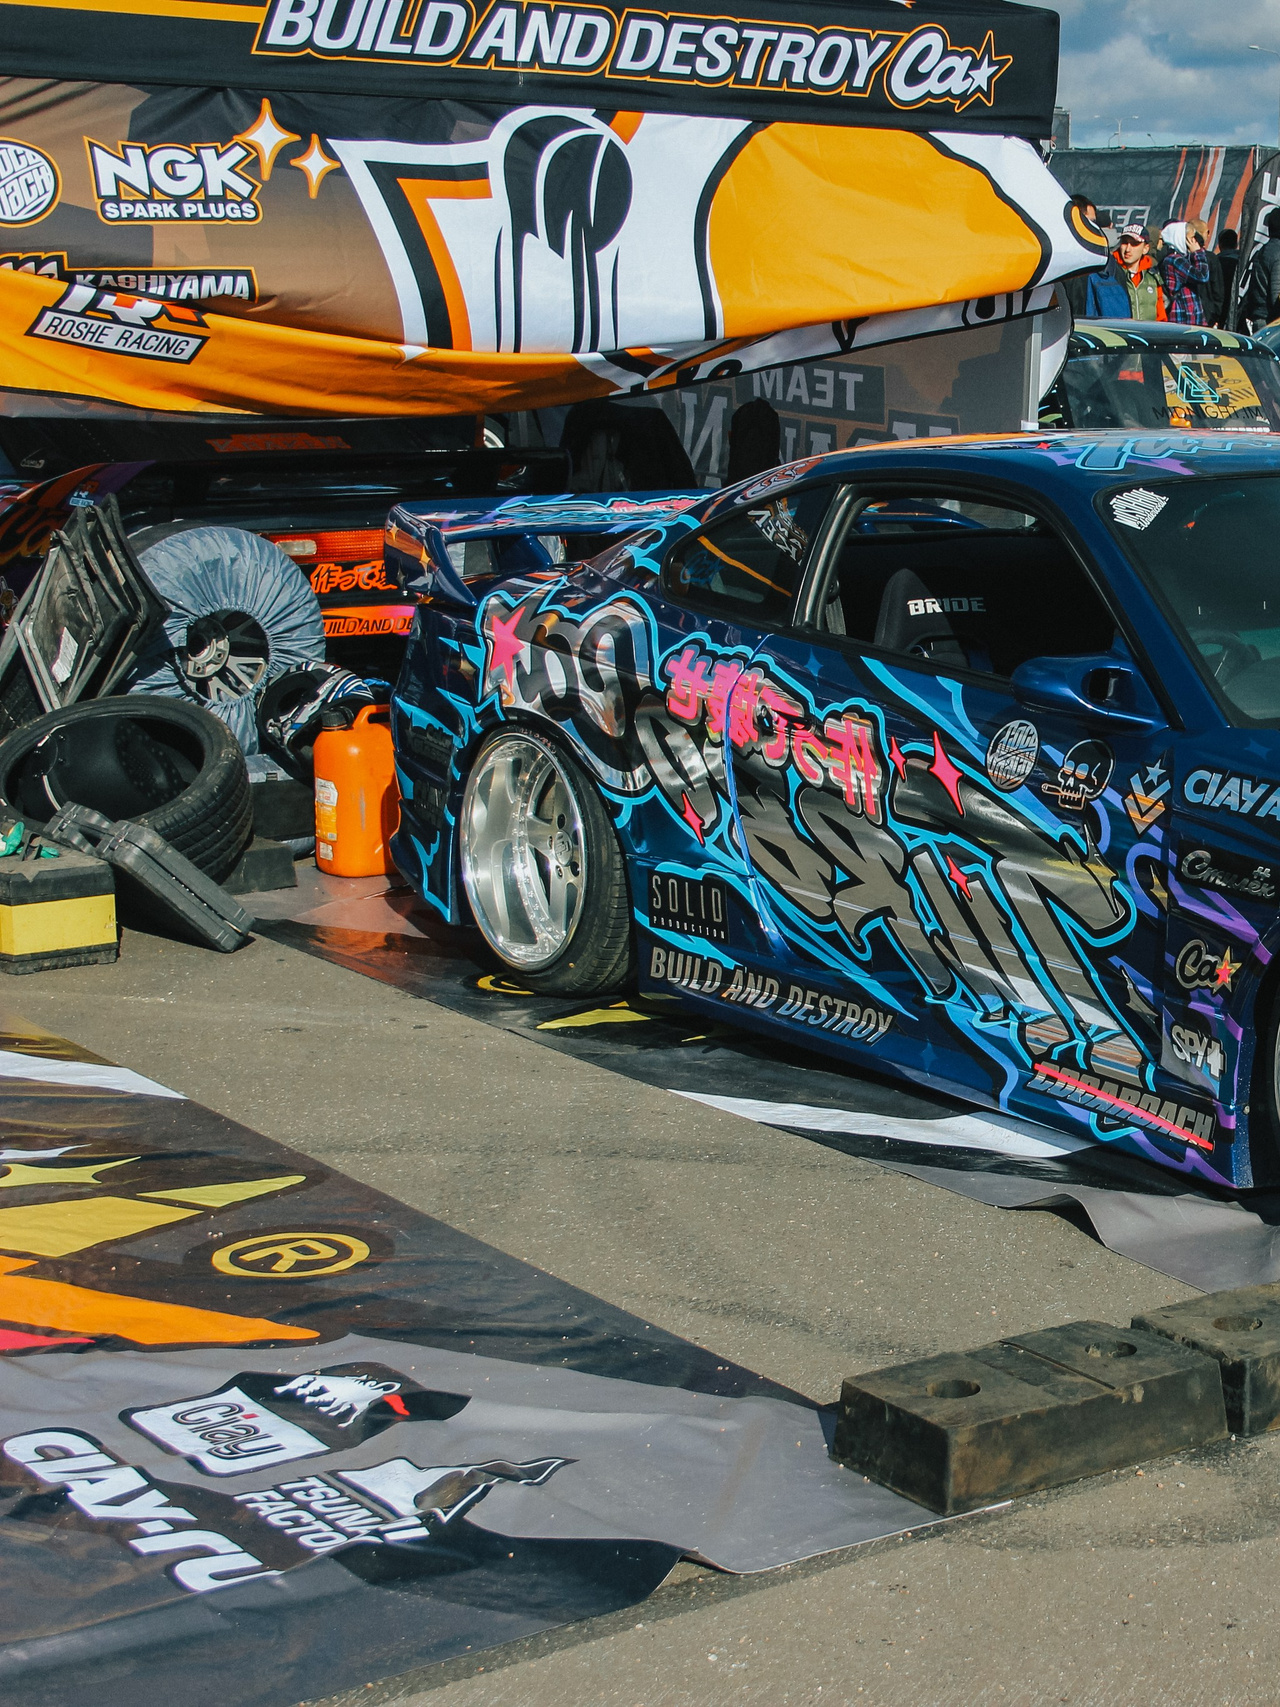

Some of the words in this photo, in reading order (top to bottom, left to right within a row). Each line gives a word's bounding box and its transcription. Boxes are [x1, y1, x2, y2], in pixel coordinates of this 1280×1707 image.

[265, 0, 472, 57] BUILD
[470, 2, 612, 68] AND
[616, 18, 891, 95] DESTROY
[94, 141, 253, 199] NGK
[105, 202, 180, 219] SPARK
[184, 202, 257, 219] PLUGS
[75, 274, 250, 300] KASHIYAMA
[45, 316, 114, 345] ROSHE
[116, 330, 191, 357] RACING
[907, 597, 986, 616] BRIDE
[324, 618, 358, 635] UILD
[359, 618, 395, 633] AND
[652, 874, 724, 923] SOLID
[652, 915, 726, 939] PRODUCTION
[649, 946, 723, 994] BUILD
[721, 968, 781, 1009] AND
[776, 984, 894, 1044] DESTROY
